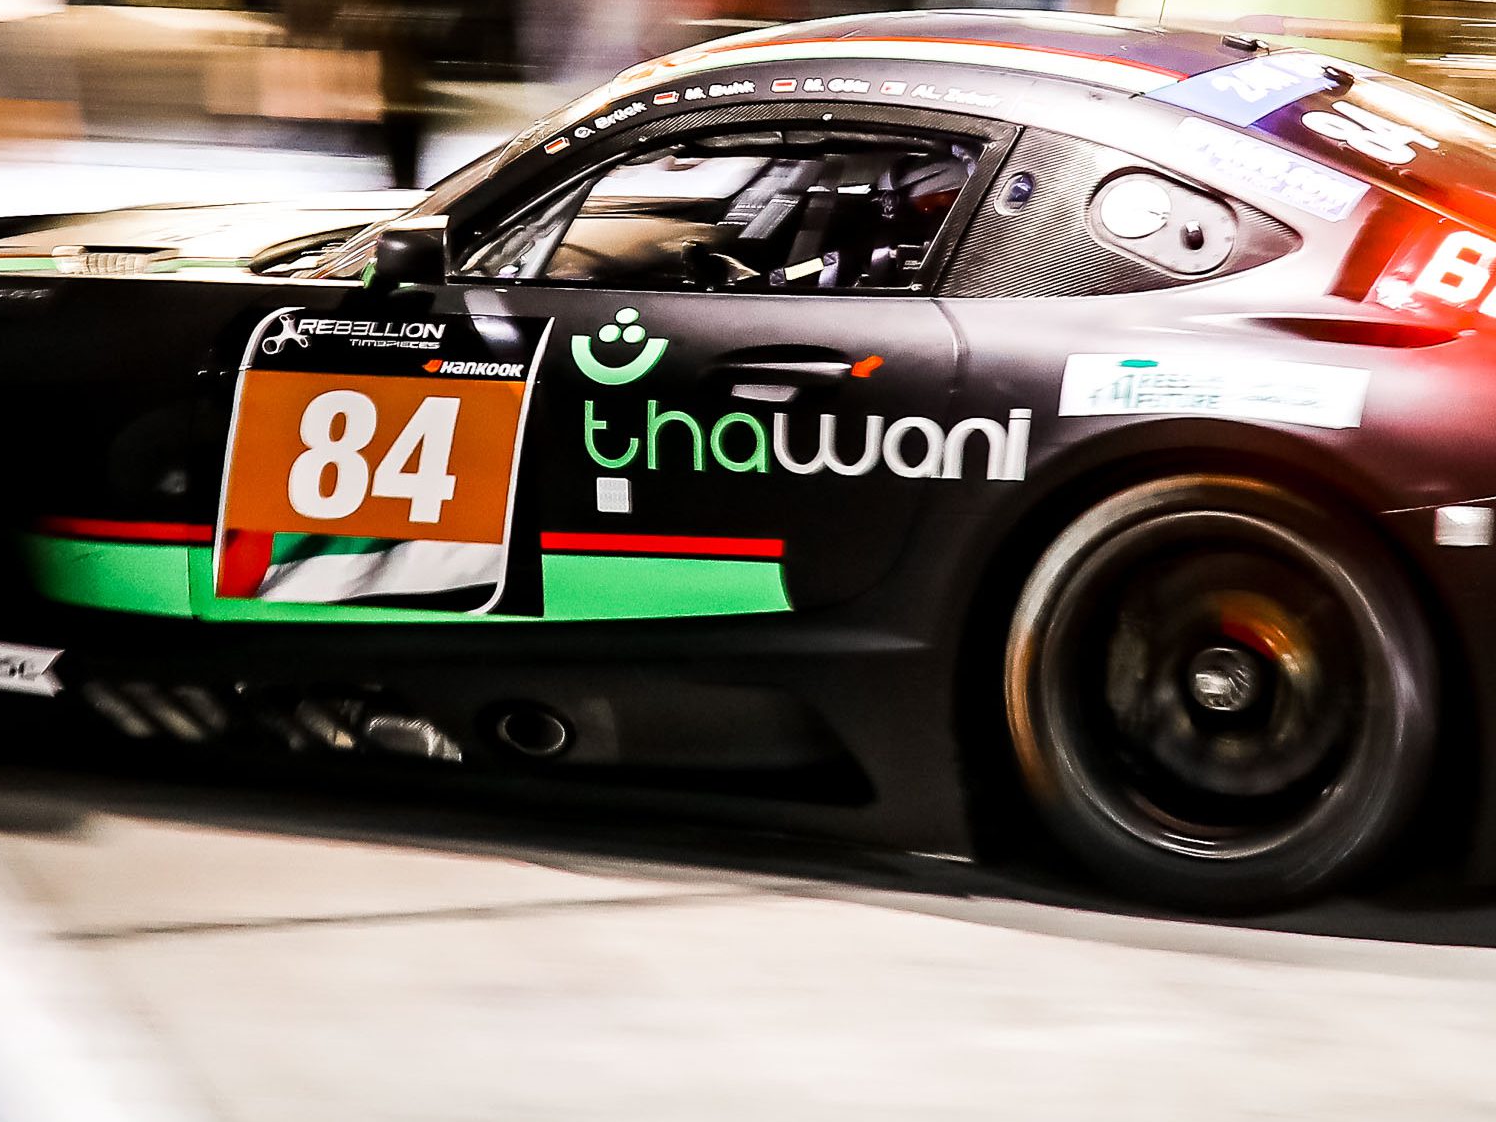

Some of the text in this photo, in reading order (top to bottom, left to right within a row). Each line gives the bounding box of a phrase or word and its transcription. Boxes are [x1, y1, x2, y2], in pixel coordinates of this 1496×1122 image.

[297, 318, 446, 339] REBELLION
[349, 338, 441, 350] TIMEPIECES
[287, 388, 461, 524] 84
[584, 399, 1032, 481] thawani
